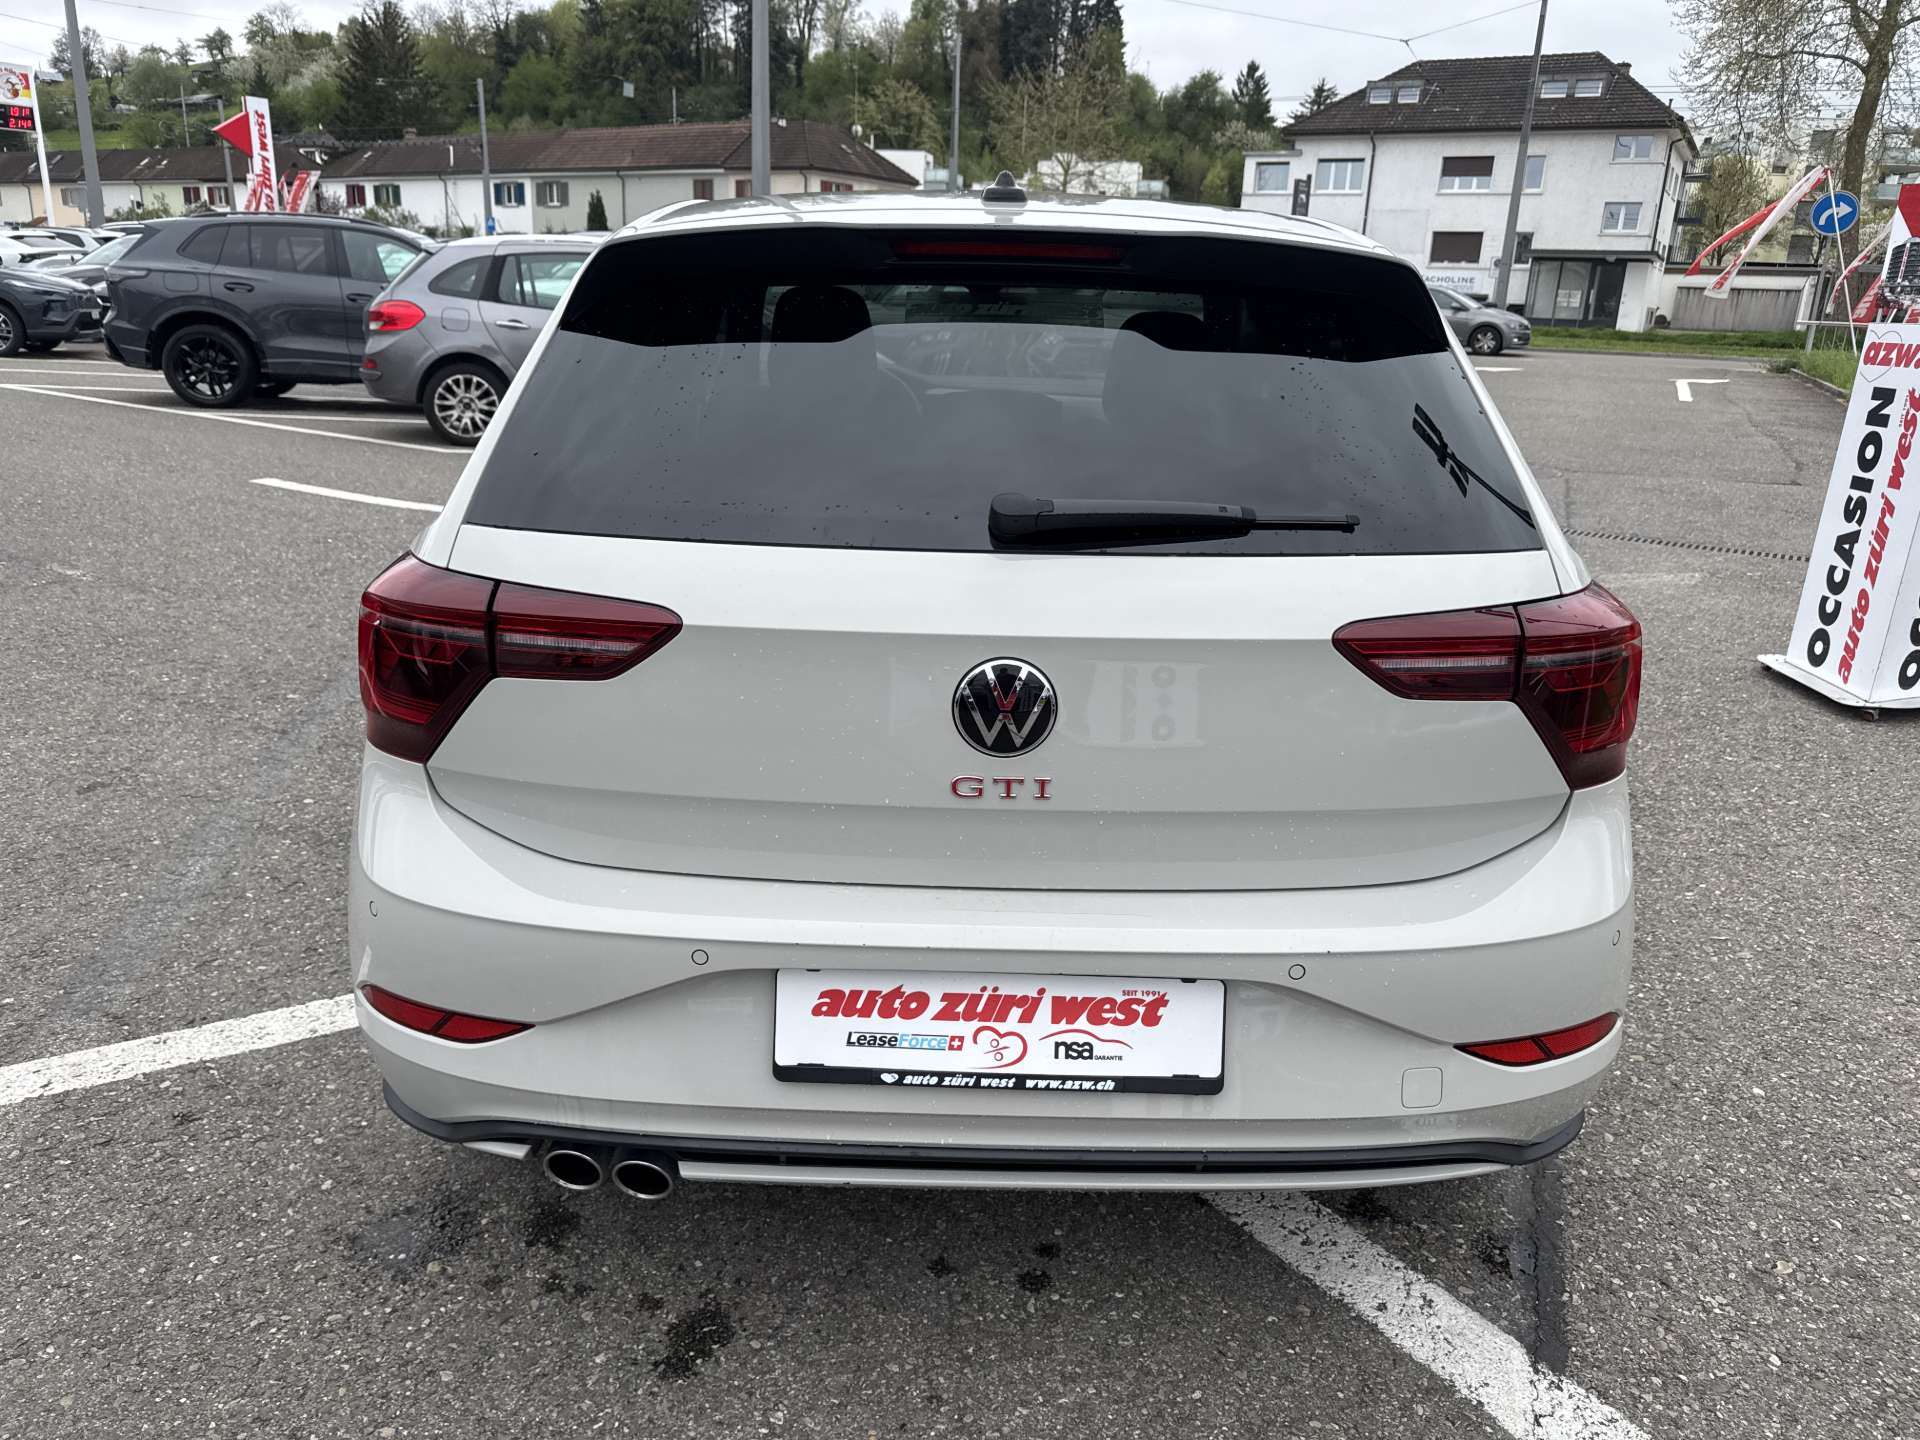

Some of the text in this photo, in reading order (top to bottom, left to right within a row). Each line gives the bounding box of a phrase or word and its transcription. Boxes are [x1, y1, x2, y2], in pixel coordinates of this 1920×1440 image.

[1425, 275, 1476, 284] ACHOLINE
[1807, 386, 1897, 668] OCCASION
[1838, 387, 1920, 685] auto züri west
[951, 775, 1051, 800] GTI
[1122, 989, 1138, 997] SEIT
[811, 984, 1170, 1028] auto züri west
[846, 1031, 948, 1050] LeaseForce
[1054, 1041, 1094, 1061] nsa
[903, 1074, 1116, 1091] auto züri west www.azw.ch
